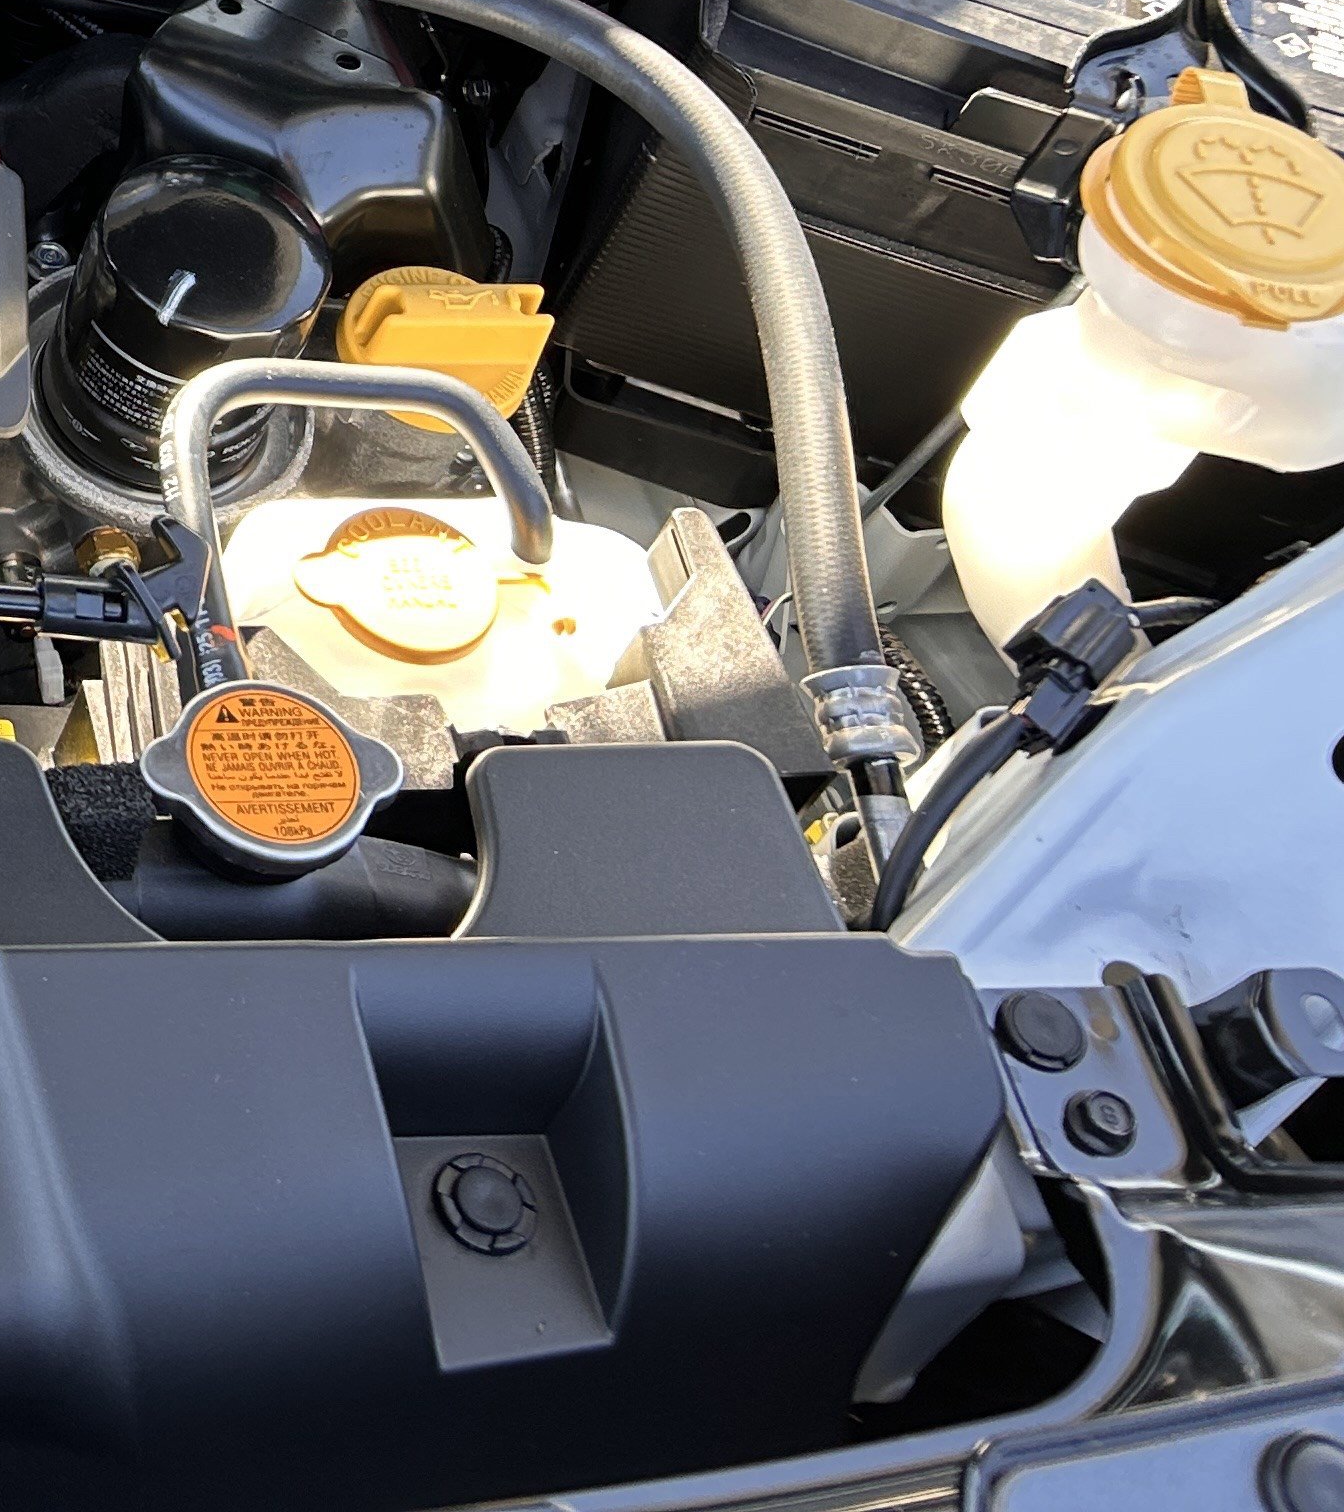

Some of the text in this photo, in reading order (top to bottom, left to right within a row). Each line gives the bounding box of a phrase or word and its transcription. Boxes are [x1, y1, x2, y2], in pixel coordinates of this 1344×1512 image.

[1249, 281, 1316, 305] PULL
[336, 511, 476, 559] COOLANT
[238, 706, 304, 718] WARNING
[202, 752, 239, 762] NEVER
[243, 751, 273, 762] OPEN
[276, 750, 310, 761] WHEN
[222, 761, 256, 772] JAMAIS
[258, 760, 295, 772] OUVRIR
[235, 802, 336, 815] AVERTISSEMENT
